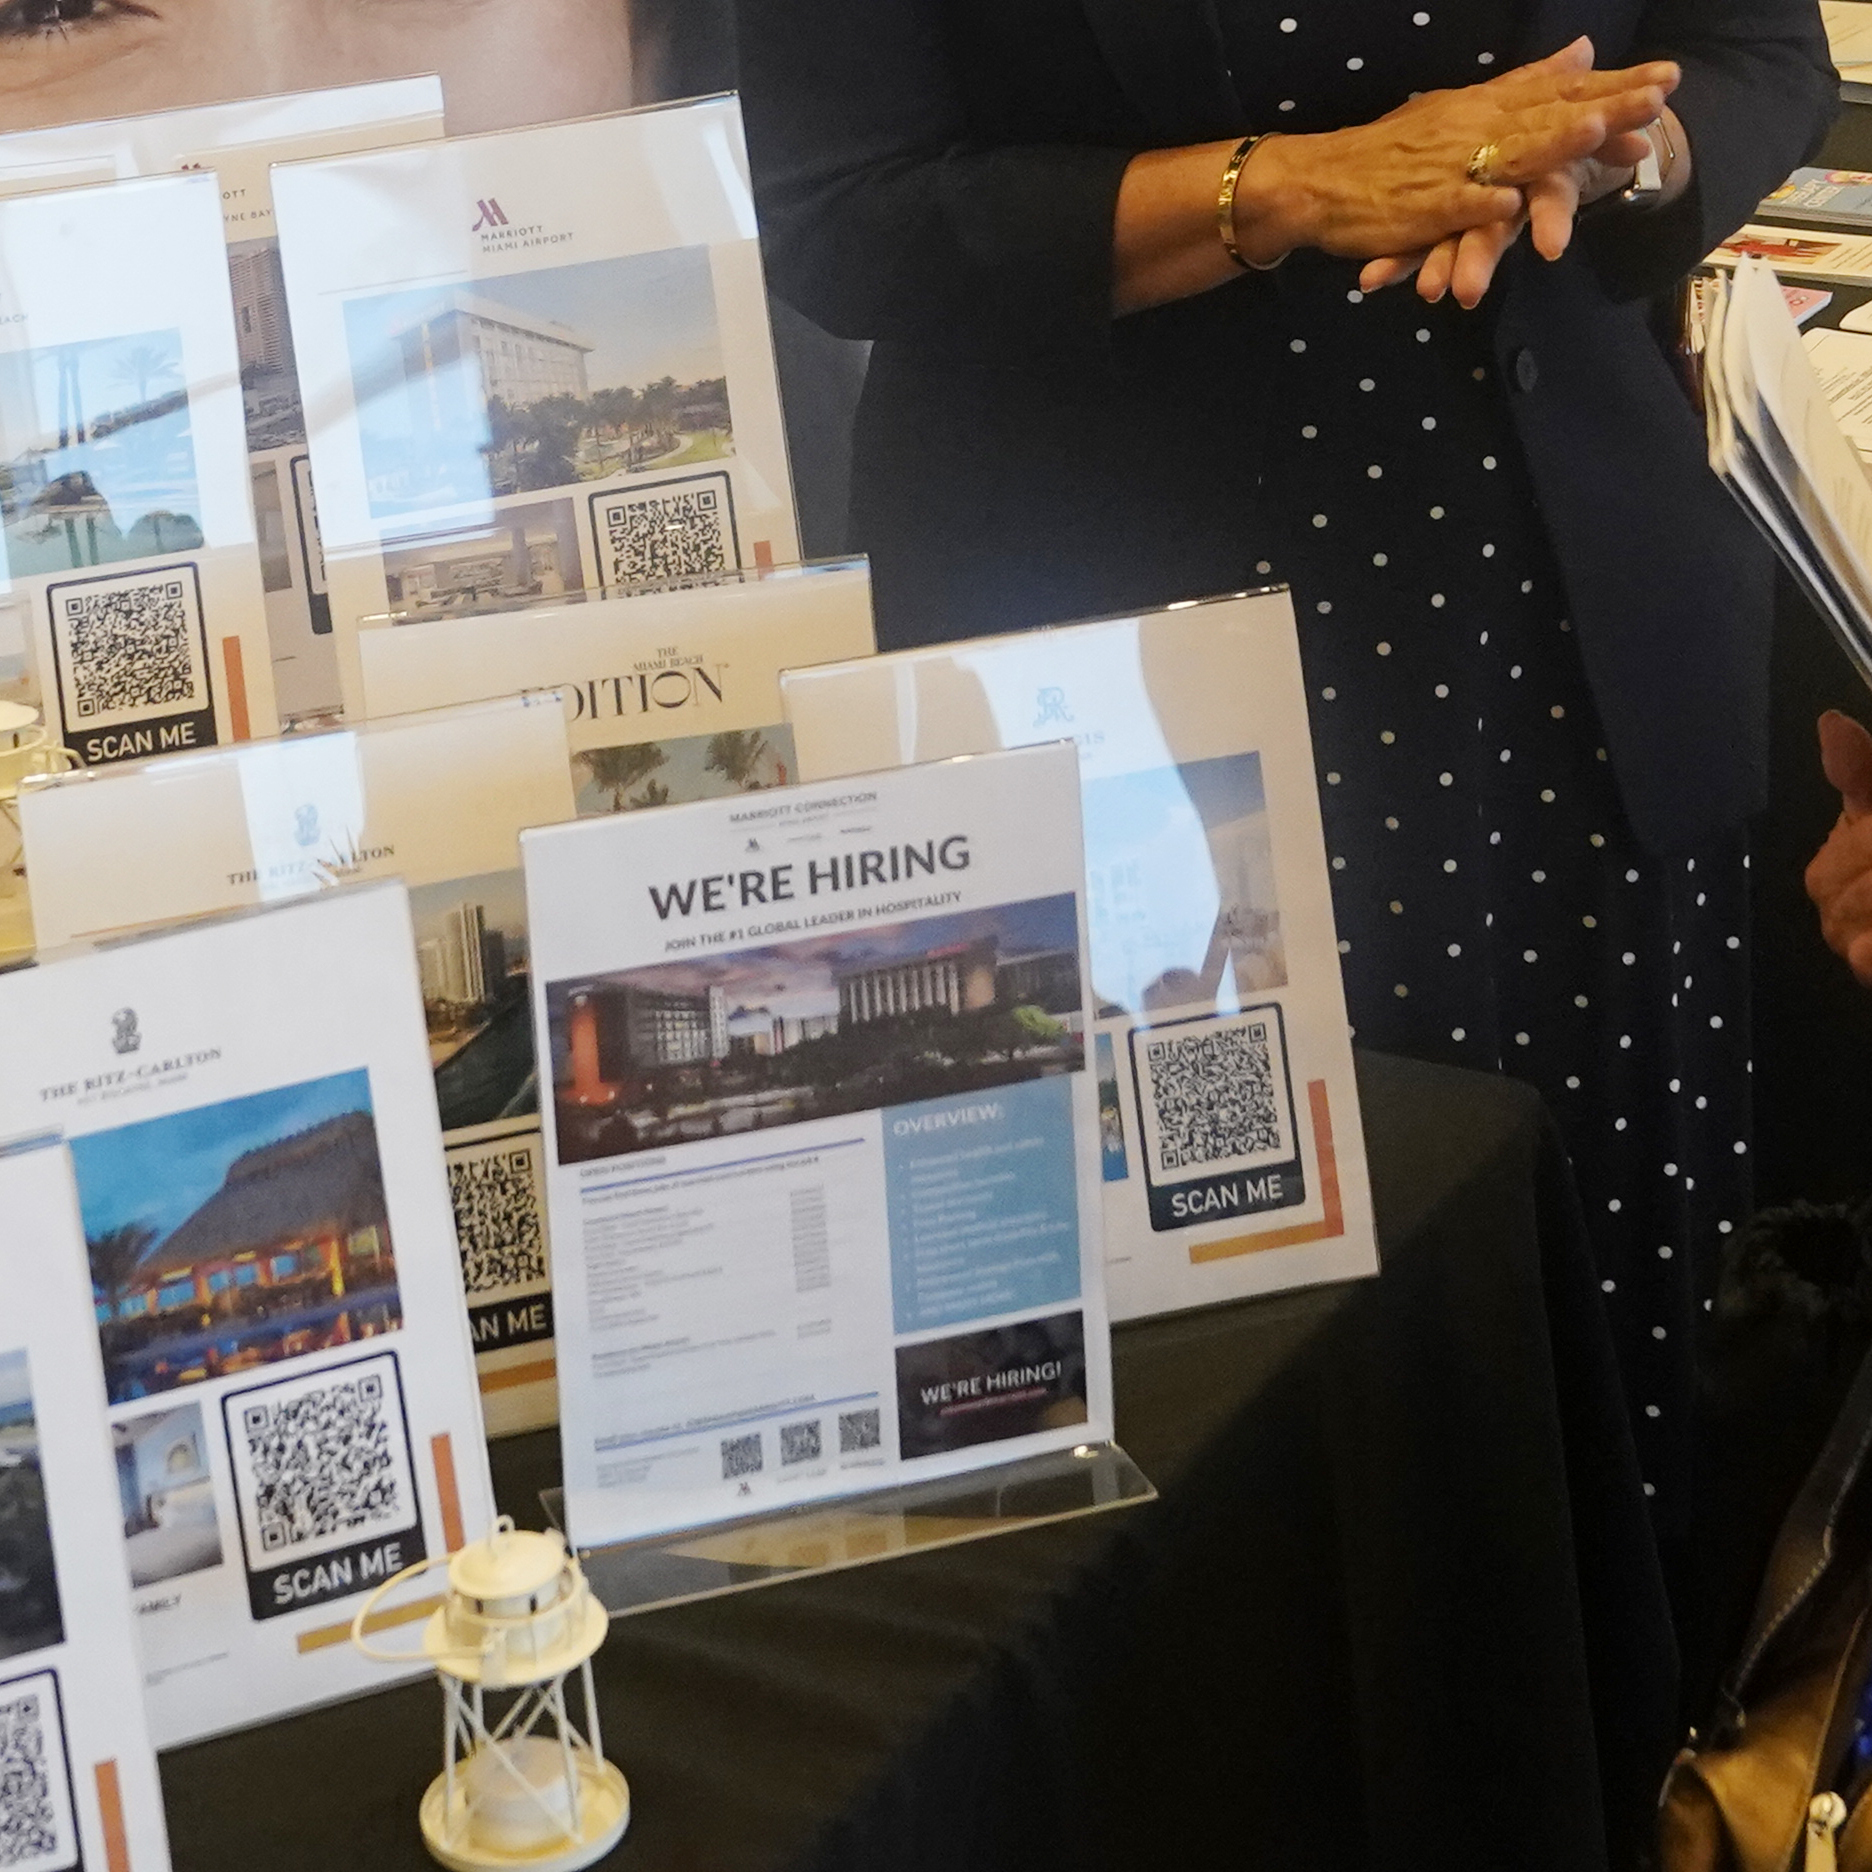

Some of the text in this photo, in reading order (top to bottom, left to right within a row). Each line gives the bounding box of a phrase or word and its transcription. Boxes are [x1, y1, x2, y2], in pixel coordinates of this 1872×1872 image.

[481, 225, 543, 241] MARRIOTT
[482, 232, 574, 254] MIAMI AIRPORT
[560, 663, 726, 722] DITION
[86, 722, 197, 762] SCAN ME
[648, 835, 970, 921] WE'RE HIRING
[700, 930, 725, 947] THE
[748, 919, 802, 938] GLOBAL
[804, 909, 855, 929] LEADER
[858, 906, 873, 919] IN
[876, 890, 962, 915] HOSPITALITY
[1171, 1174, 1283, 1217] SCAN ME
[507, 1304, 547, 1334] ME
[986, 1360, 1062, 1393] HIRING!
[273, 1542, 404, 1605] SCAN ME
